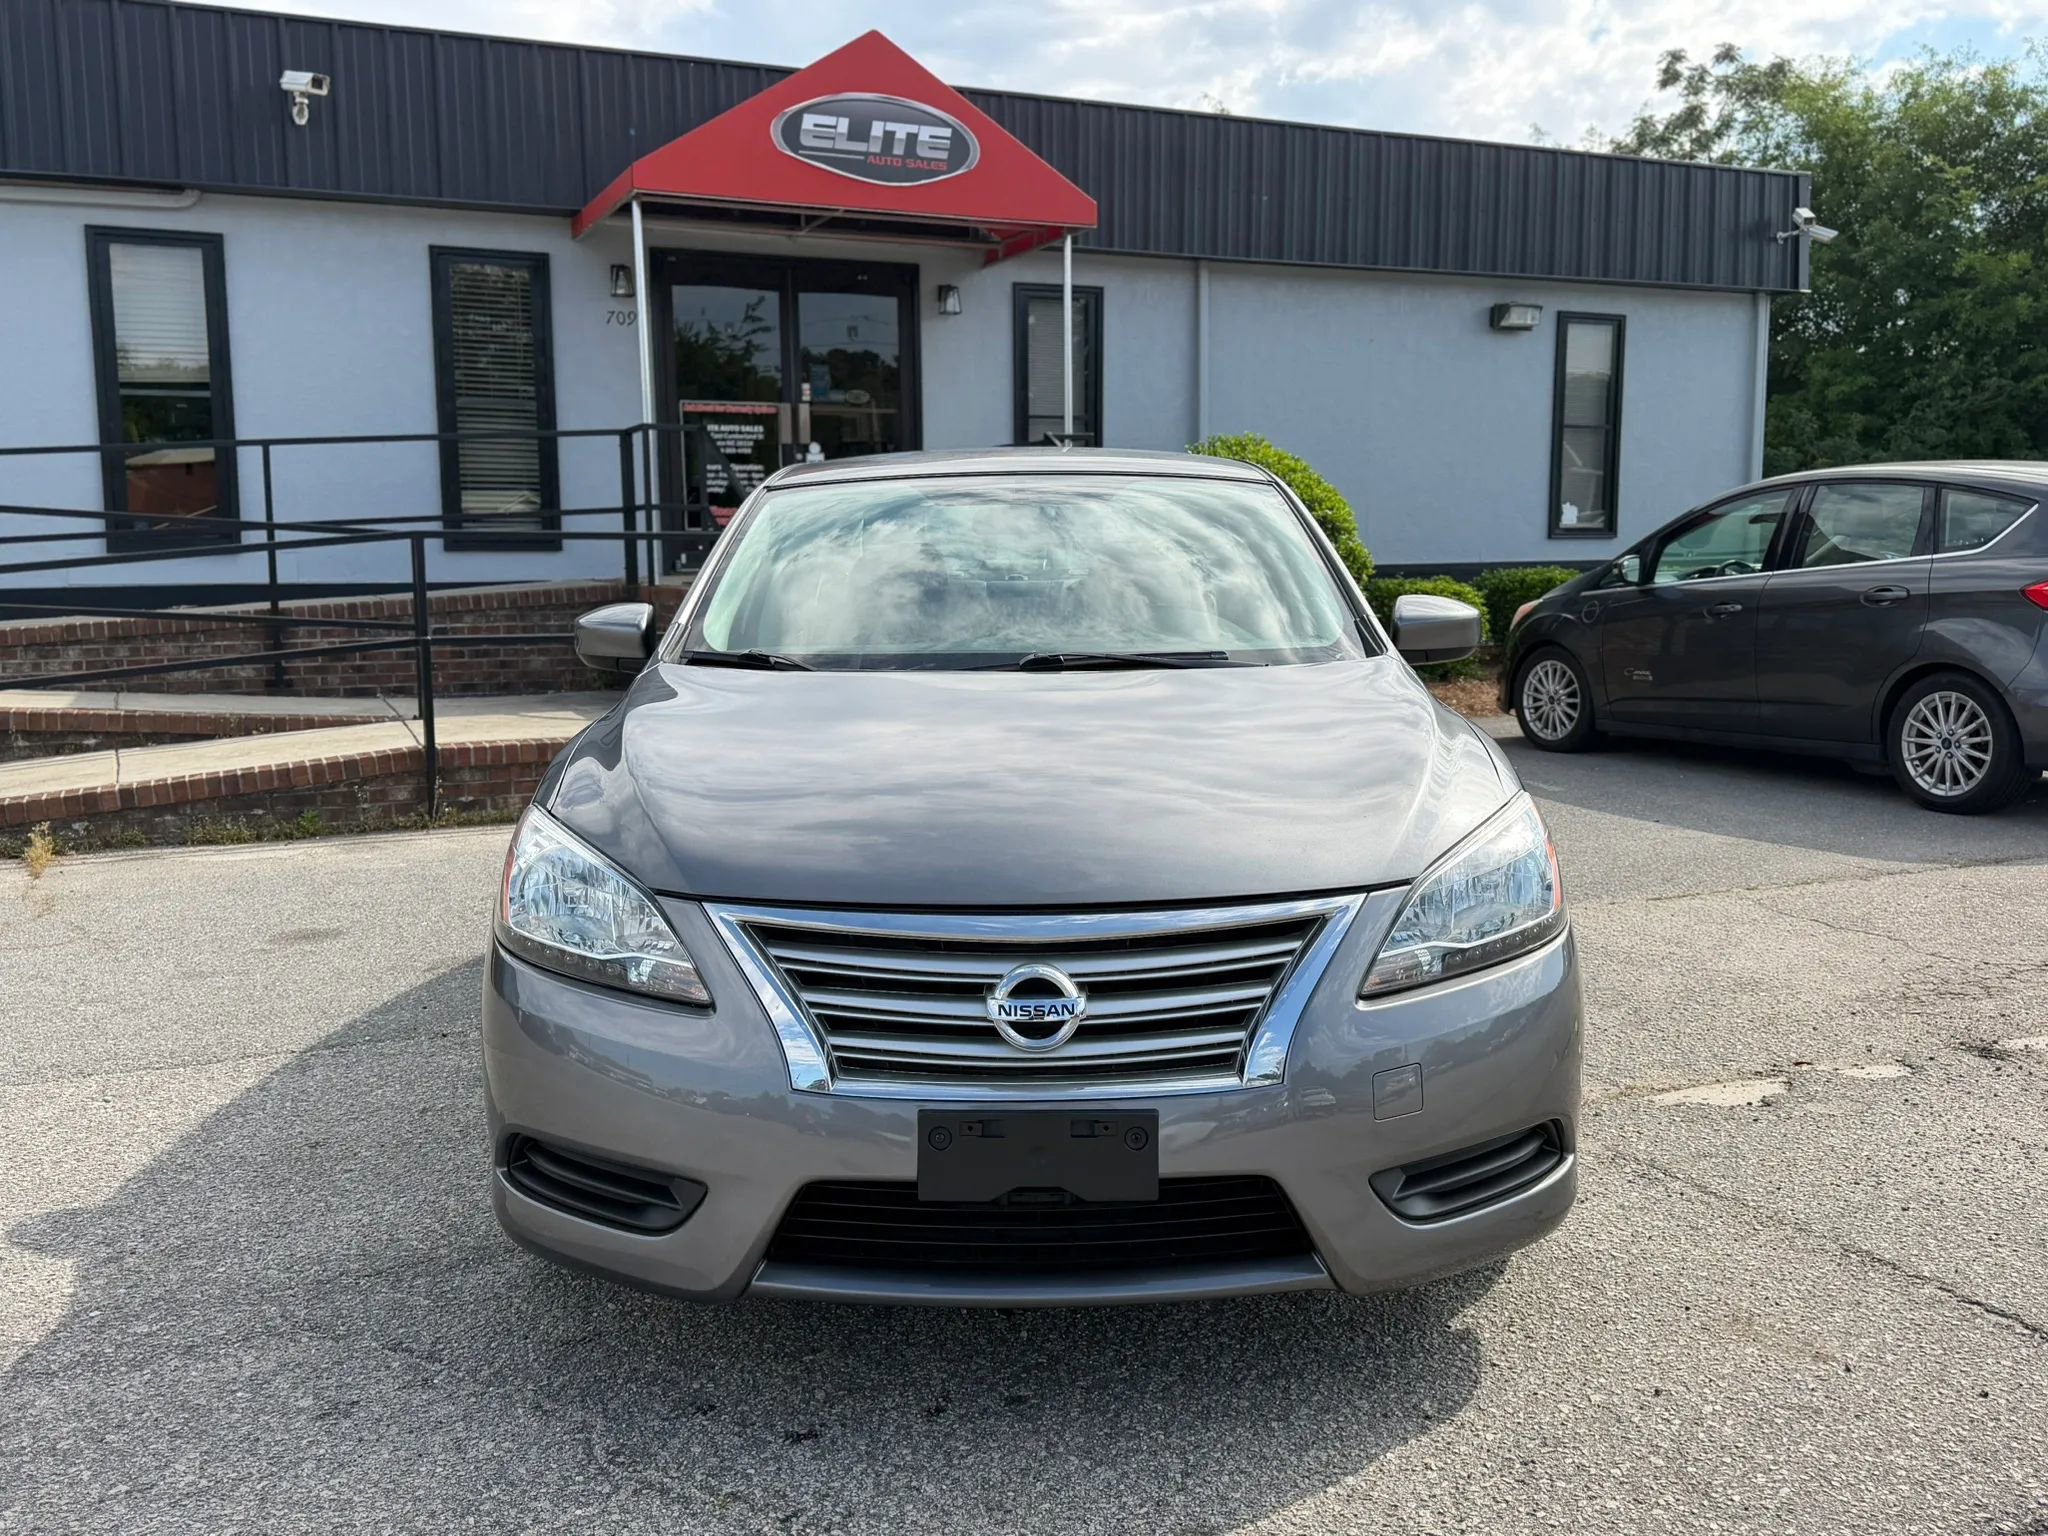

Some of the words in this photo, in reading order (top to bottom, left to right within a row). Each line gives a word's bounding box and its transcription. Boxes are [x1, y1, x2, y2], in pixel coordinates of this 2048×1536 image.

[800, 113, 952, 160] ELITE
[866, 155, 902, 168] AUTO
[905, 158, 948, 171] SALES
[606, 310, 637, 327] 709
[741, 425, 764, 433] SALES
[998, 1003, 1075, 1017] NISSAN
